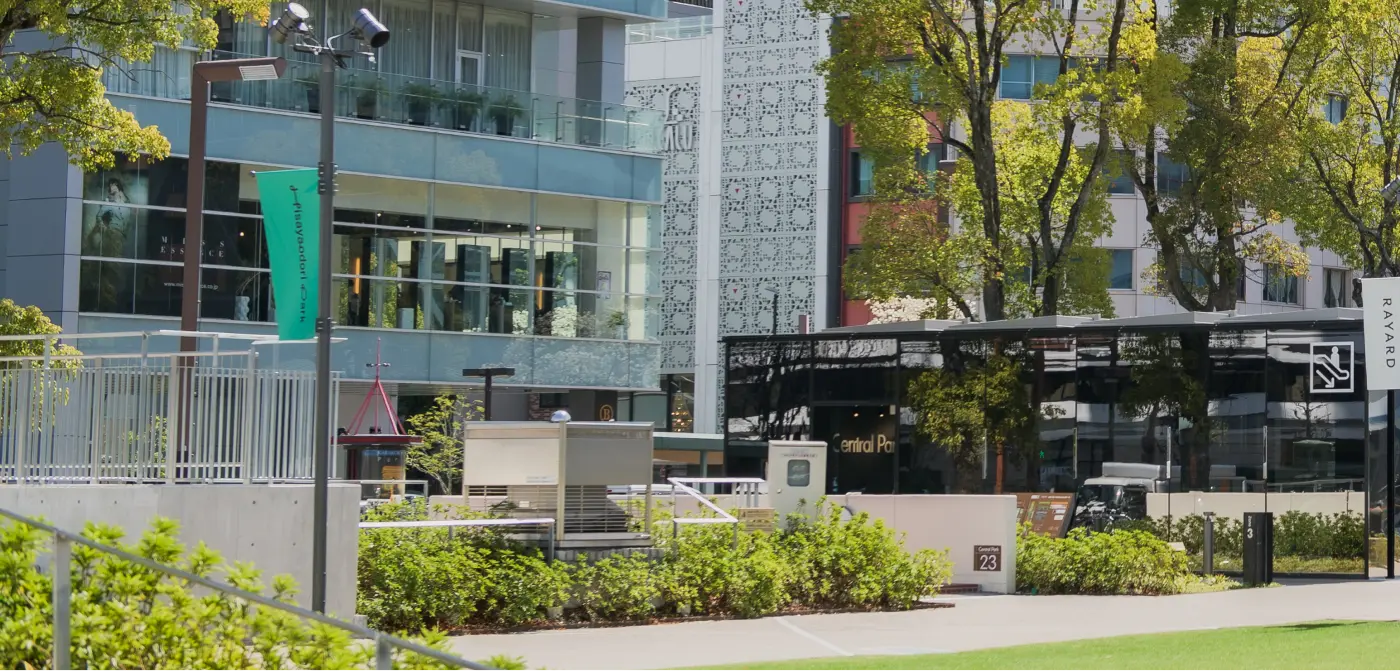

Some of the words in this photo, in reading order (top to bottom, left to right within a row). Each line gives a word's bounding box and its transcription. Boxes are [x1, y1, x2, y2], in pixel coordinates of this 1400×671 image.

[161, 245, 225, 257] ESSCE
[1382, 298, 1396, 368] RAYARD
[832, 432, 875, 453] Central
[877, 434, 896, 453] Par
[980, 554, 997, 570] 23
